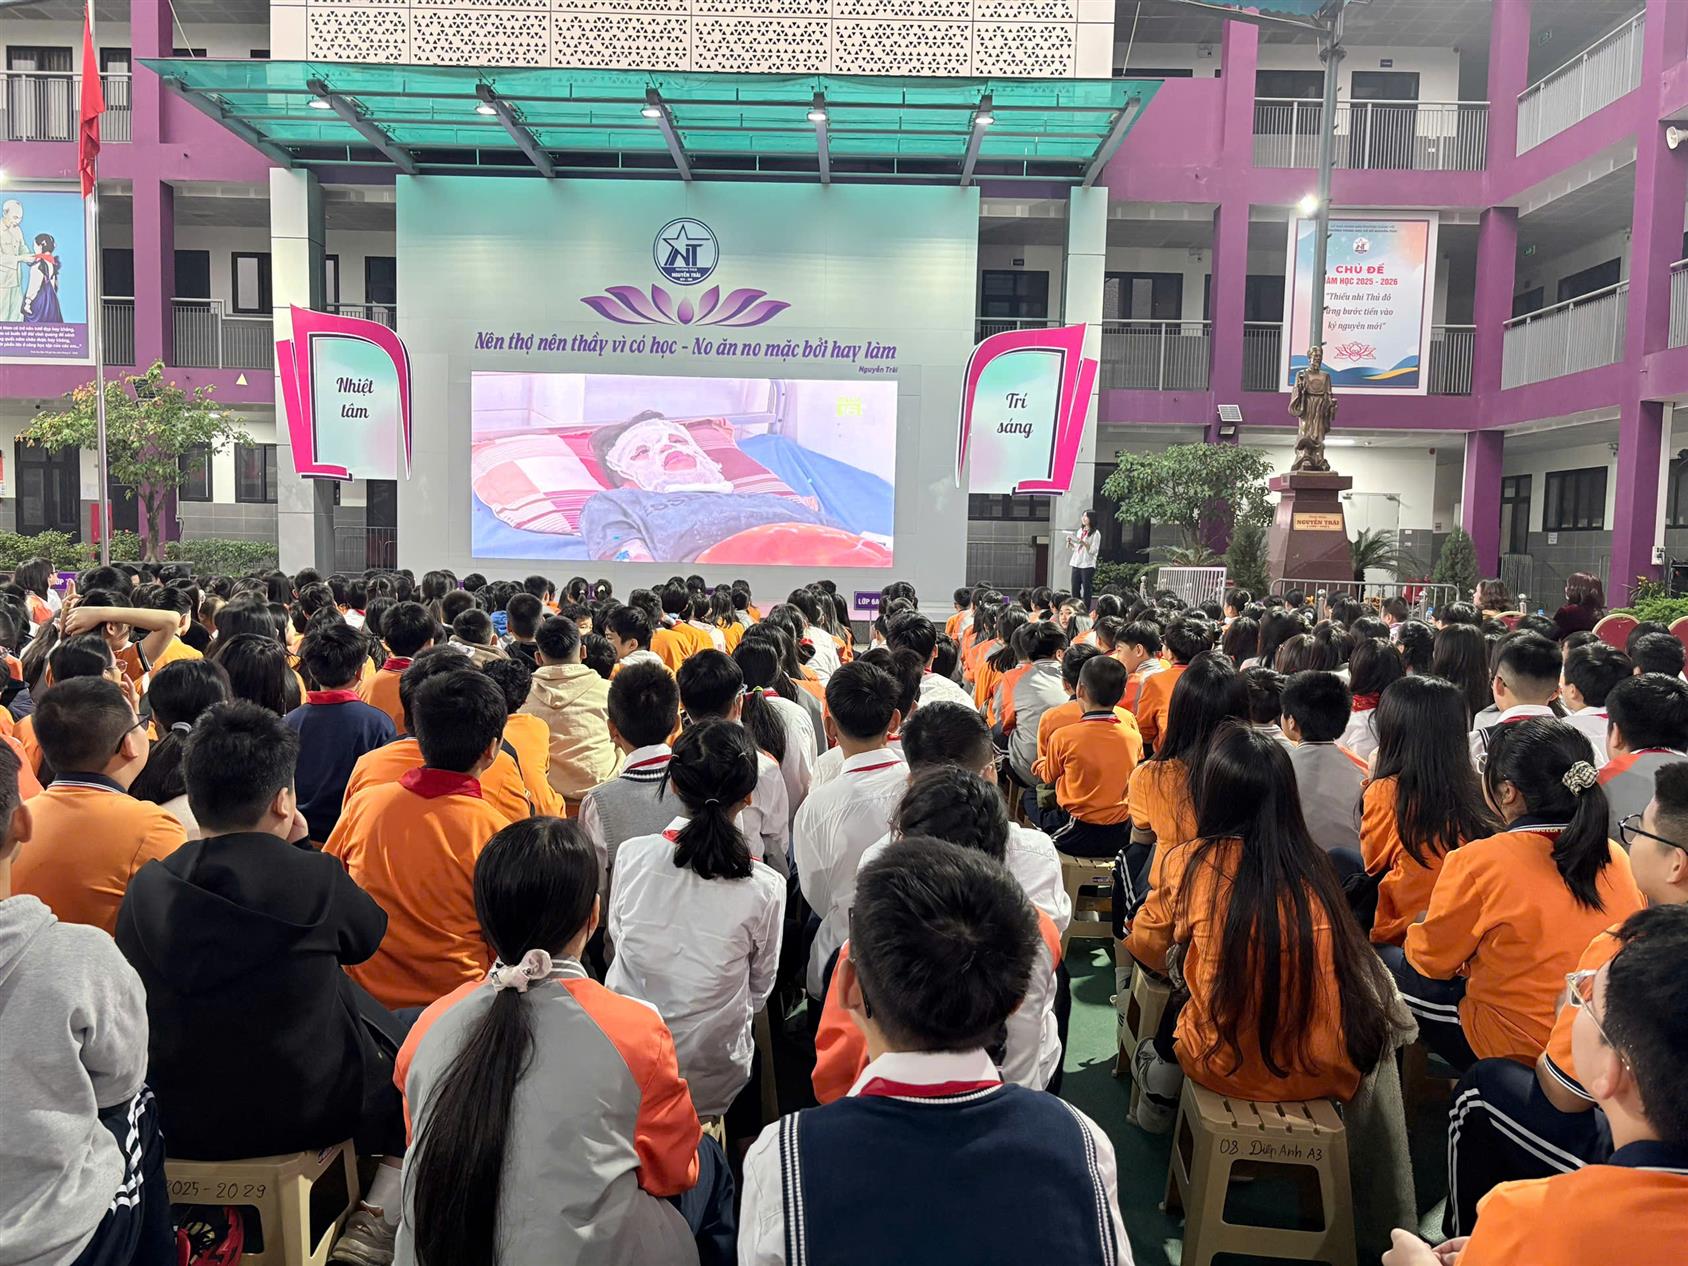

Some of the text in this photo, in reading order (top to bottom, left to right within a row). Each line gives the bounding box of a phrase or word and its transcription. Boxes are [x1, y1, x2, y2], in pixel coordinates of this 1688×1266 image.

[1335, 263, 1363, 274] CHỦ
[1339, 277, 1355, 286] HỌC
[1356, 277, 1374, 286] 2025
[1380, 278, 1398, 286] 2026
[1351, 293, 1364, 301] nhi
[1380, 308, 1394, 316] vào
[474, 331, 504, 350] Nên
[507, 332, 534, 354] thợ
[537, 333, 567, 352] nên
[571, 331, 608, 357] thầy
[612, 335, 626, 353] vì
[629, 334, 646, 354] có
[650, 336, 678, 358] học
[692, 337, 713, 356] No
[716, 338, 737, 357] ăn
[740, 342, 761, 358] no
[764, 339, 800, 362] mặc
[802, 337, 828, 358] bởi
[830, 340, 861, 362] hay
[864, 340, 897, 360] làm
[336, 377, 374, 397] Nhiệt
[1005, 392, 1029, 409] Trí
[341, 403, 370, 419] tâm
[996, 418, 1034, 439] sáng
[858, 596, 871, 605] LỚP
[1279, 1143, 1302, 1158] Anh
[1306, 1147, 1322, 1161] A3
[216, 1182, 267, 1199] 2029
